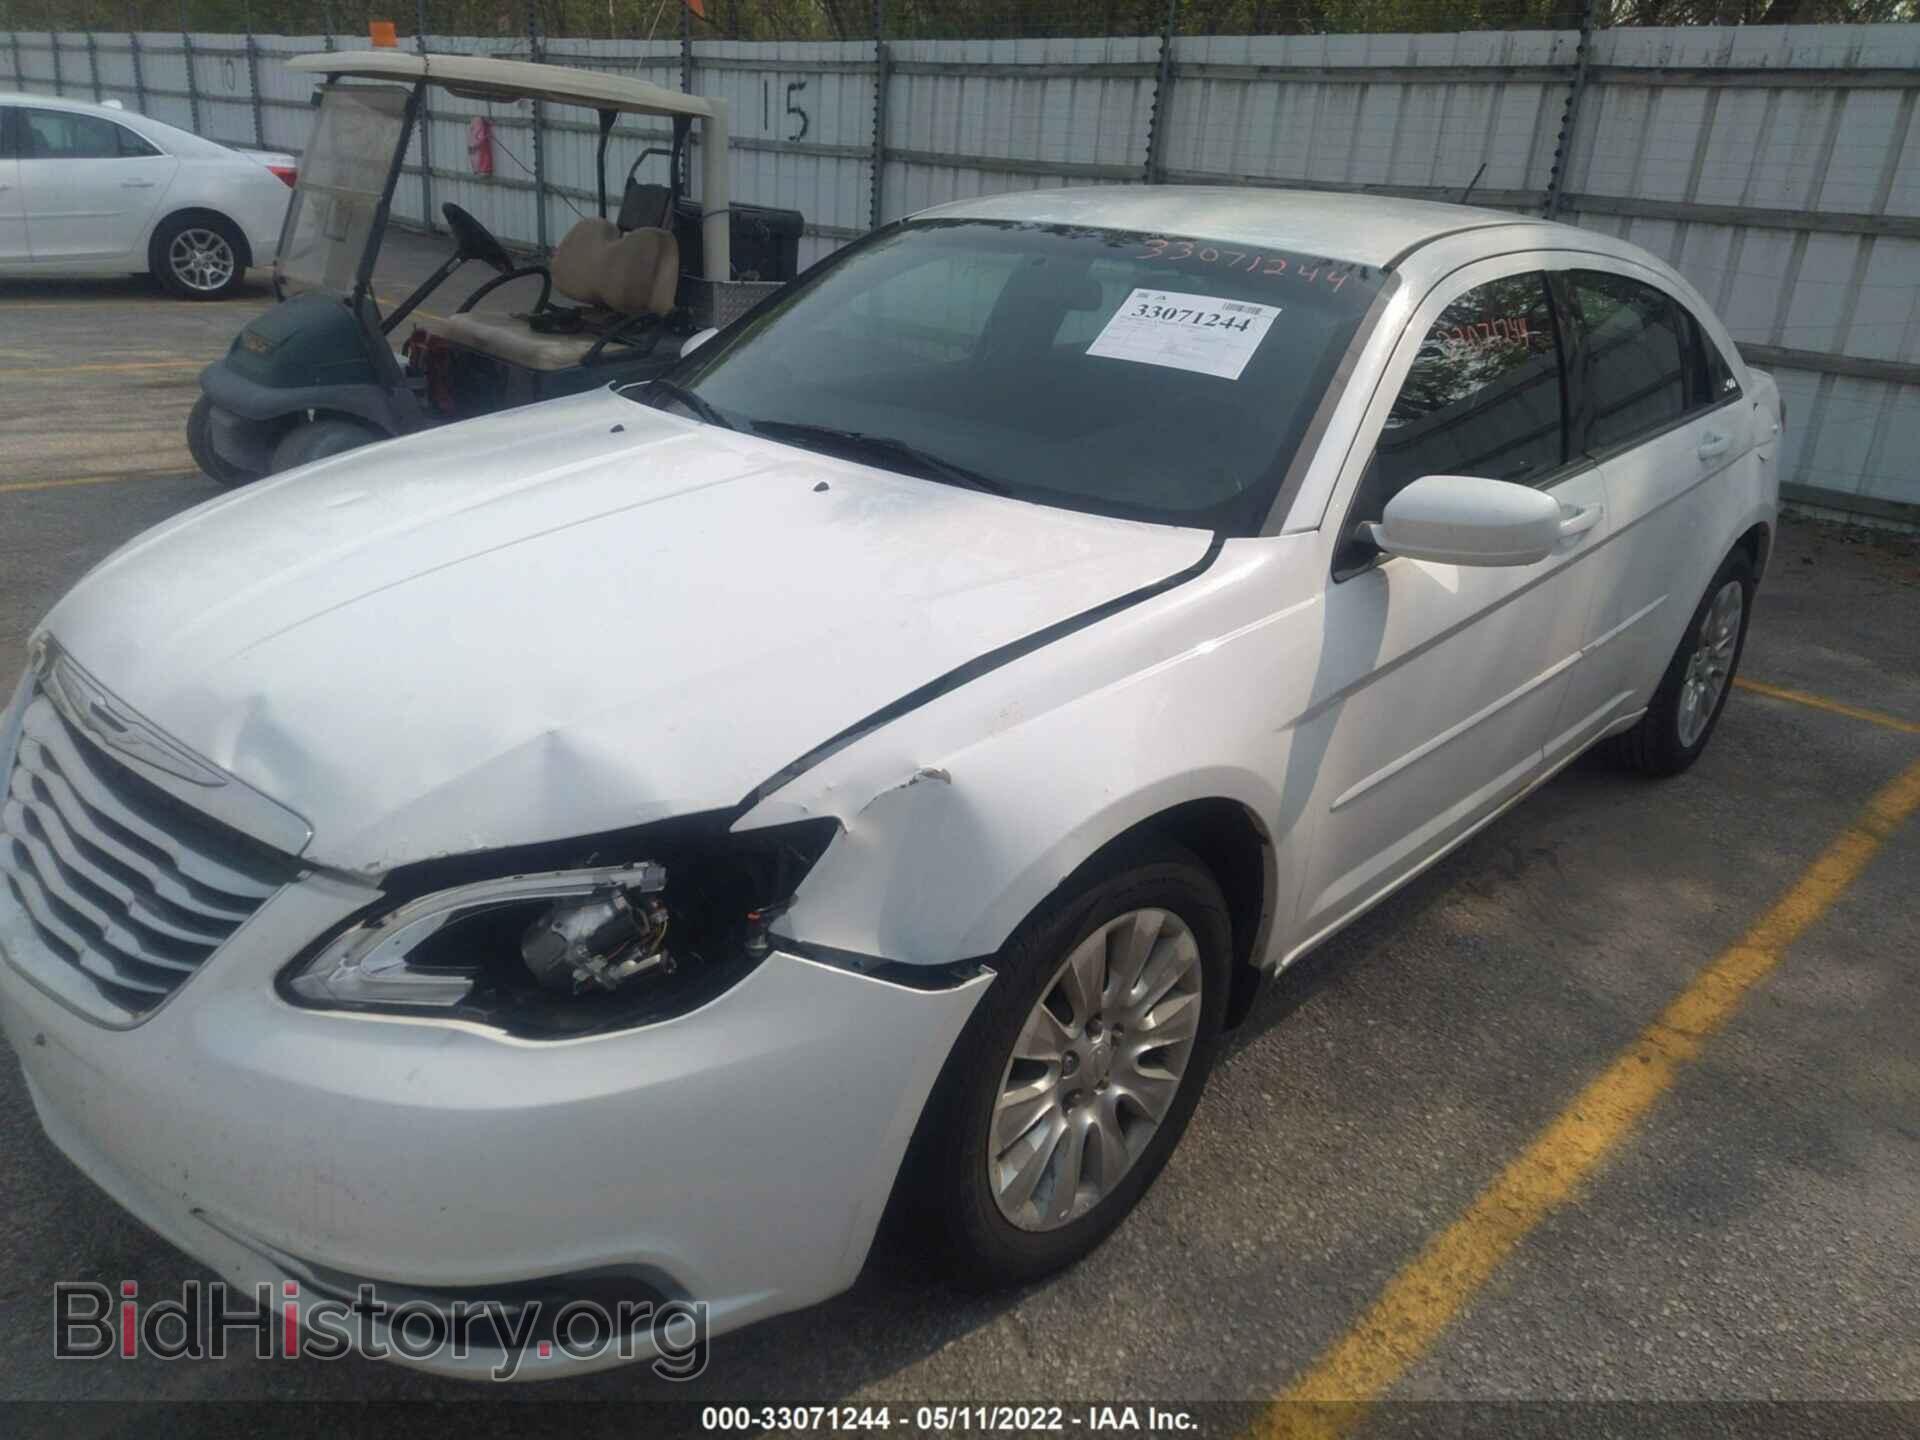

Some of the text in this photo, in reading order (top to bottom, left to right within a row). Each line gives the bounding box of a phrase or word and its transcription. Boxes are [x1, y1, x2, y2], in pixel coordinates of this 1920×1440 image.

[764, 80, 809, 141] 15
[1135, 238, 1349, 293] 33071244
[1131, 304, 1251, 332] 33071244
